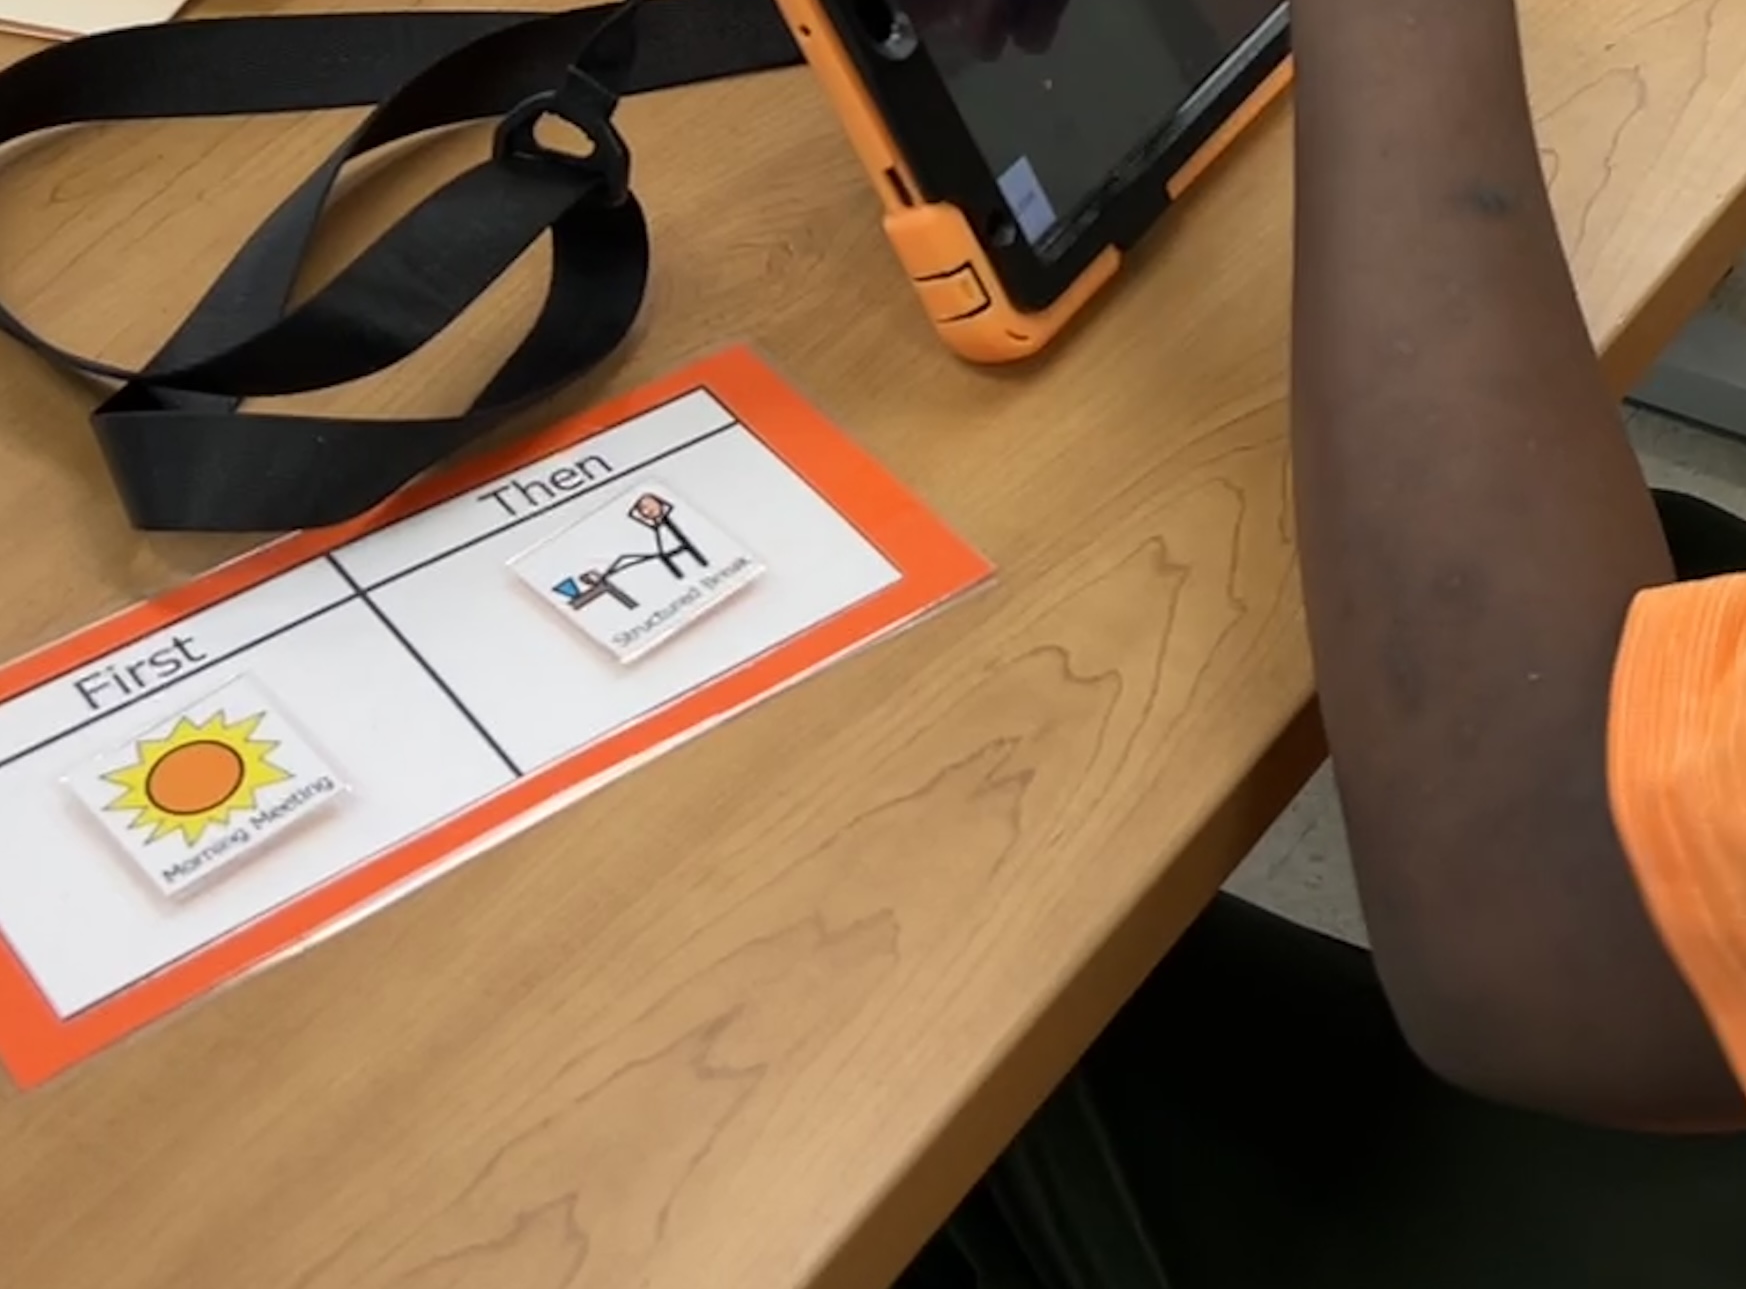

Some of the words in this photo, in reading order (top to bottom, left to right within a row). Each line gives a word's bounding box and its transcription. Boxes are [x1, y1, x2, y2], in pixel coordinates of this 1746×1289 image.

[477, 454, 613, 516] Then
[612, 587, 702, 648] Structured
[699, 558, 748, 590] Break
[73, 636, 208, 710] First
[162, 828, 249, 883] Morning
[249, 775, 336, 831] Meeting
